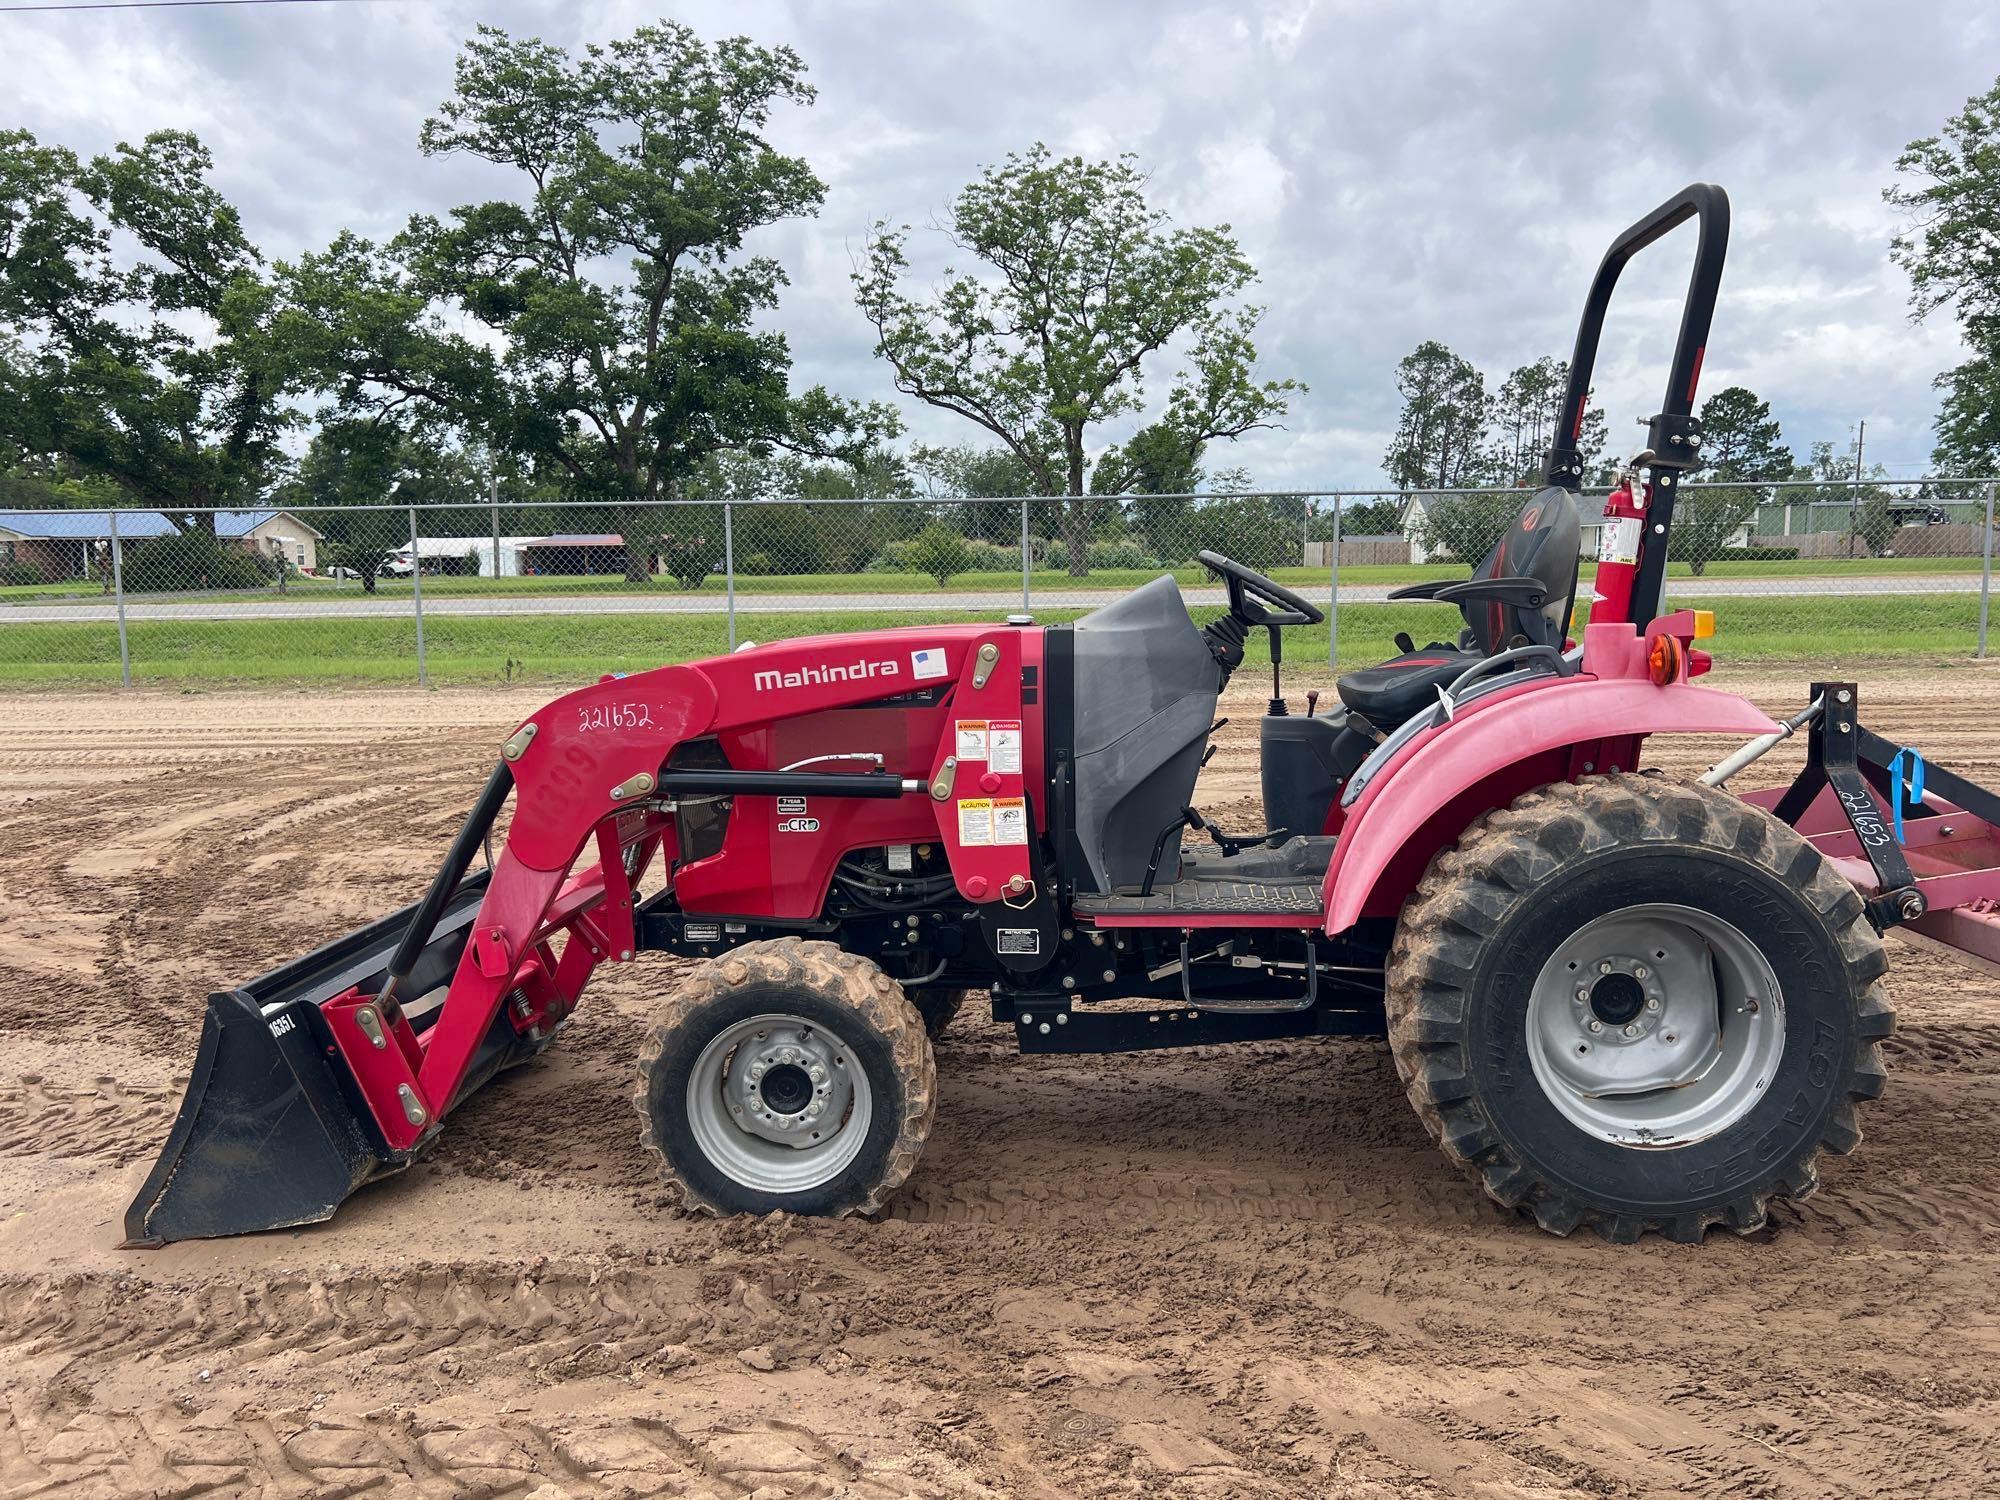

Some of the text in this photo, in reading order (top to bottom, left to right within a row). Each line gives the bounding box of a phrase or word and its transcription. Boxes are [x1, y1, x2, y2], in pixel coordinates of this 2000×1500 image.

[754, 659, 899, 692] Mahindra
[578, 703, 655, 733] 221652
[1839, 790, 1890, 847] 221653
